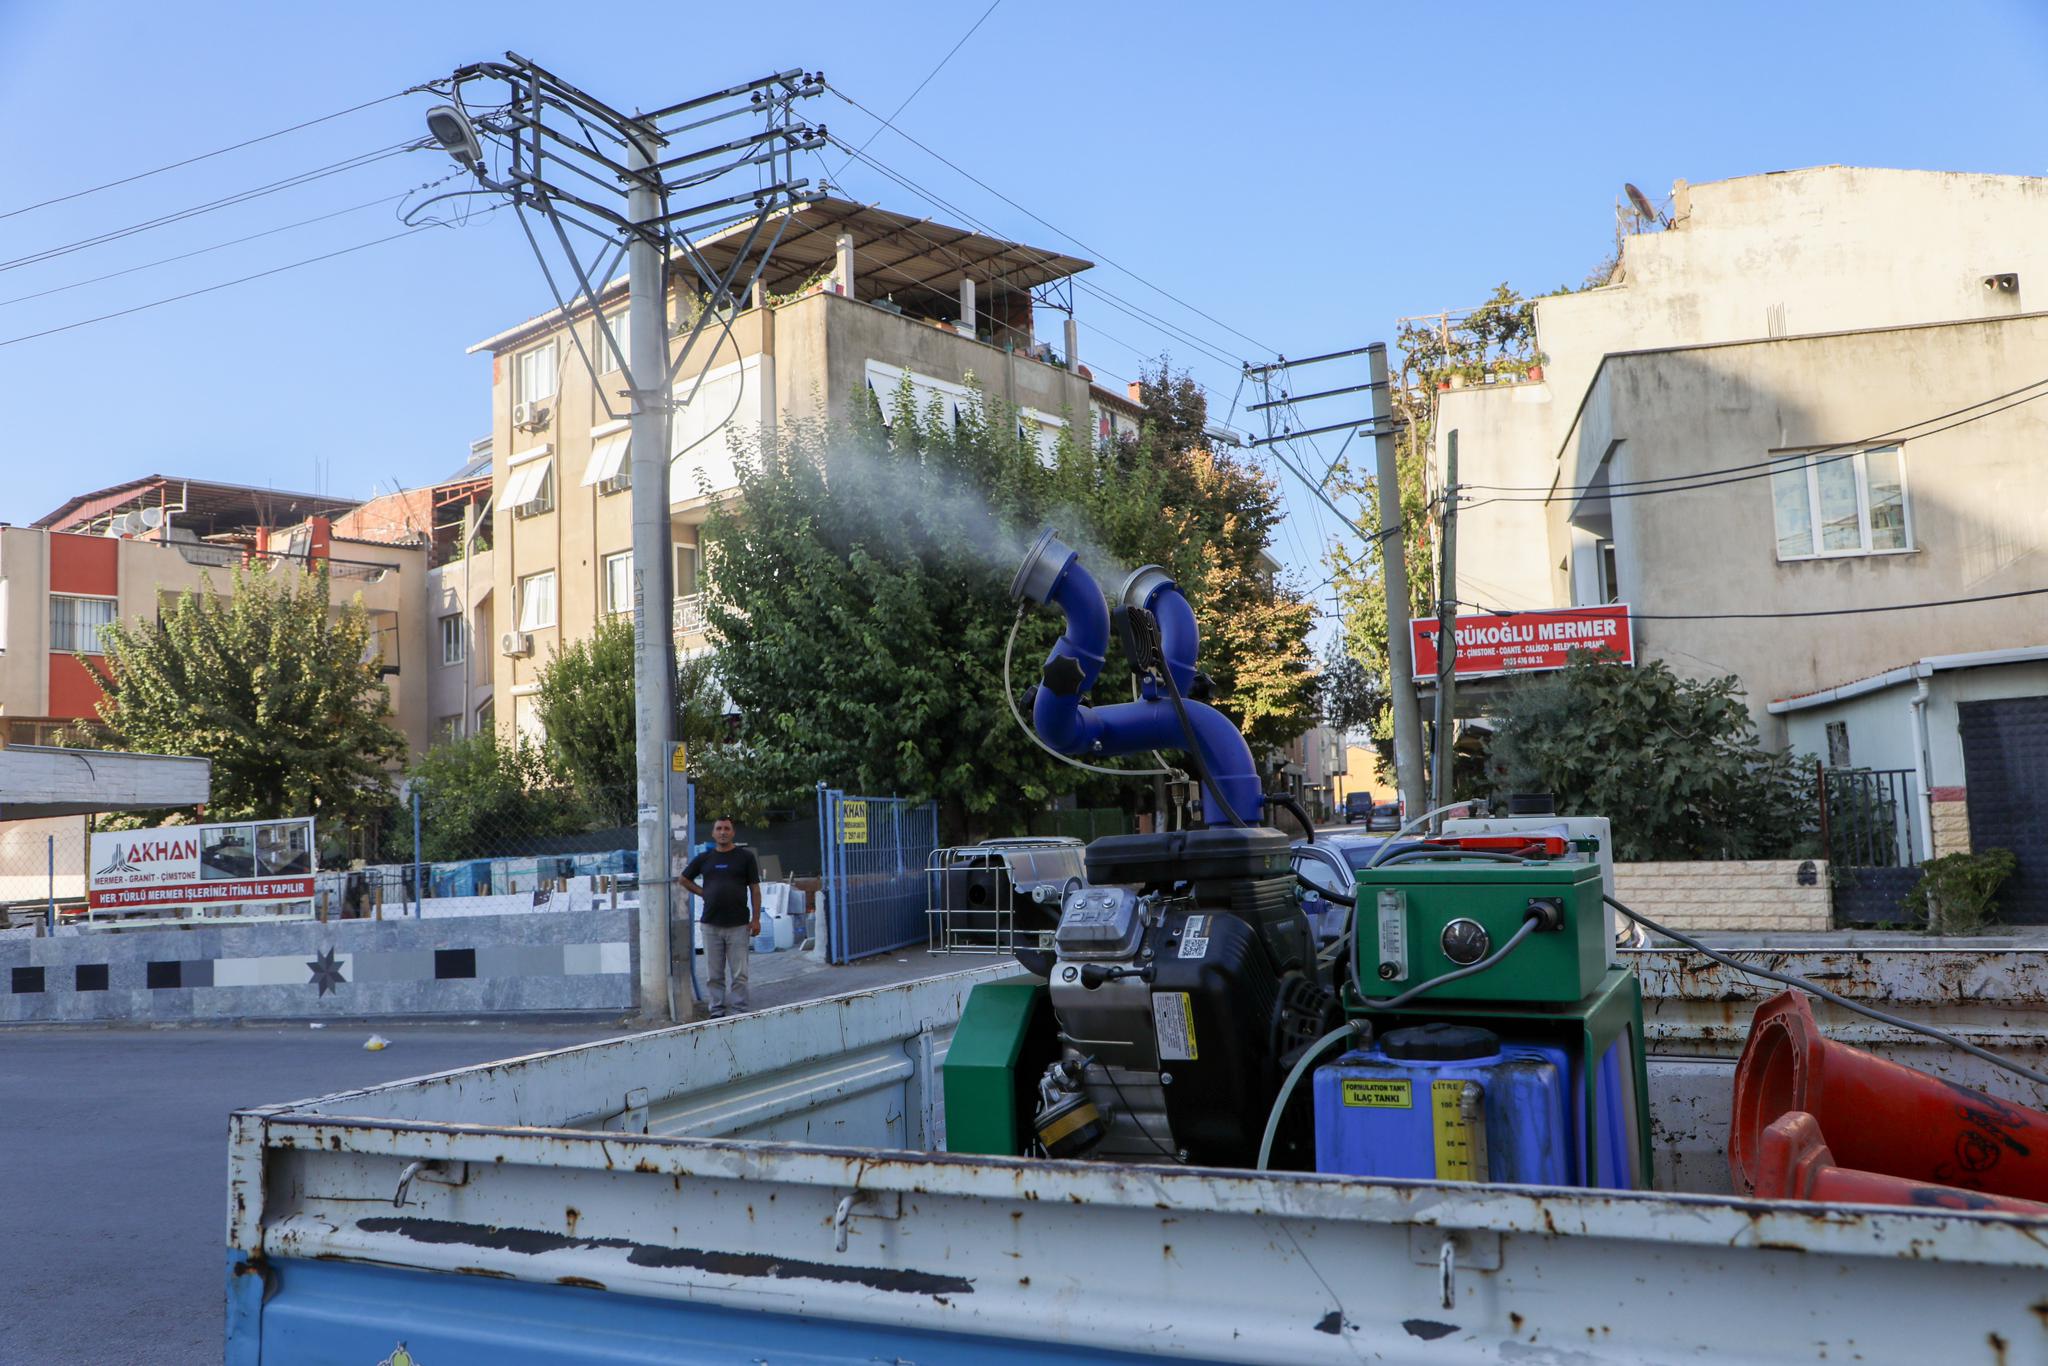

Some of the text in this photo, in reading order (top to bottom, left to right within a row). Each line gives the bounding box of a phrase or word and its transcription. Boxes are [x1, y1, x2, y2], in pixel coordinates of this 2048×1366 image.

[1430, 619, 1616, 647] YRÜKOĞLU MERMER
[840, 804, 865, 818] KHAN
[127, 840, 197, 863] AKHAN
[95, 876, 123, 885] MERMER
[129, 873, 155, 883] GRANİT
[161, 871, 196, 883] ÇİMSTONE
[100, 883, 304, 903] HER TÜRLÜ MERMER İŞLERİNİZ İTİNA İLE YAPILIR
[1354, 1092, 1399, 1103] İLAÇ TANKI
